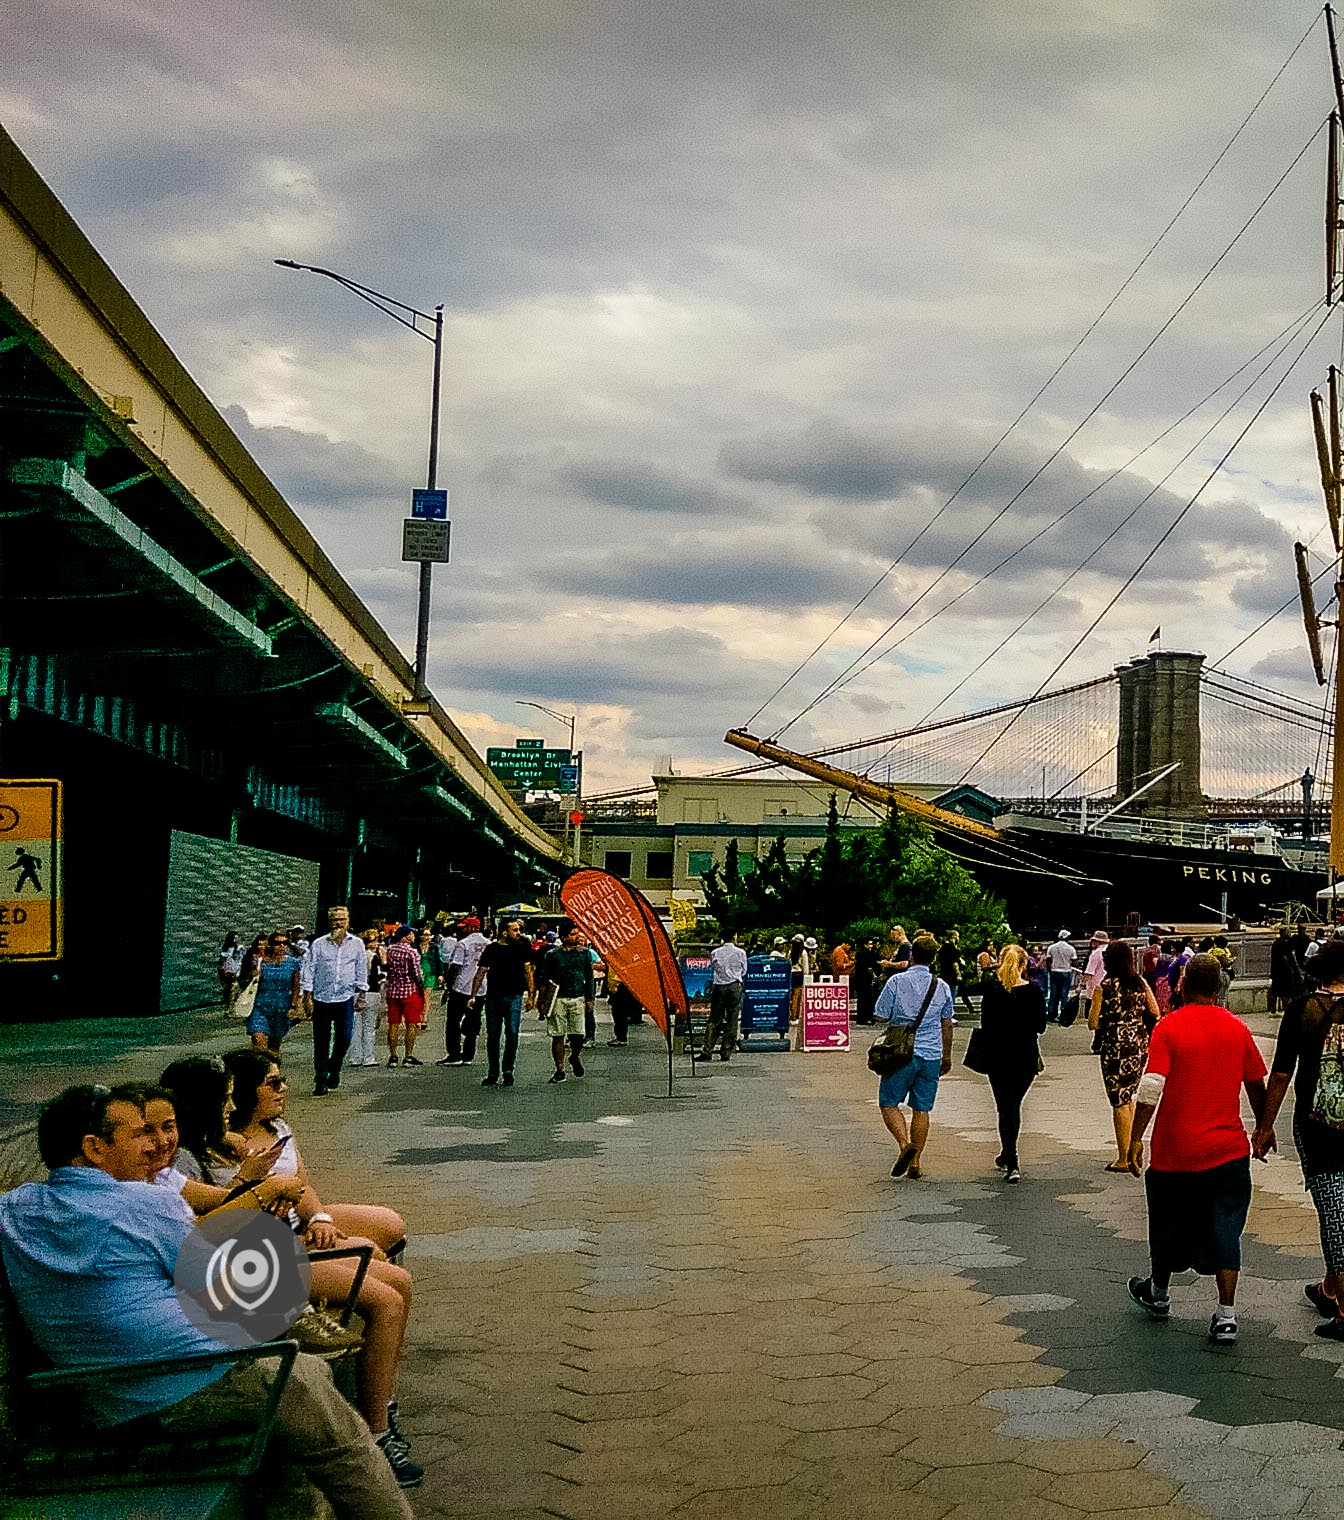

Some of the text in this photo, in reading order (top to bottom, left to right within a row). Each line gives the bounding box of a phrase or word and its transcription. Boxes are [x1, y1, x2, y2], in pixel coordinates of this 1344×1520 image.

[501, 751, 540, 760] Brooklyn
[490, 760, 538, 768] Manhattan
[1183, 865, 1272, 885] PEKING
[592, 875, 616, 898] THE
[592, 911, 643, 955] CRUISE
[806, 999, 847, 1010] TOURS
